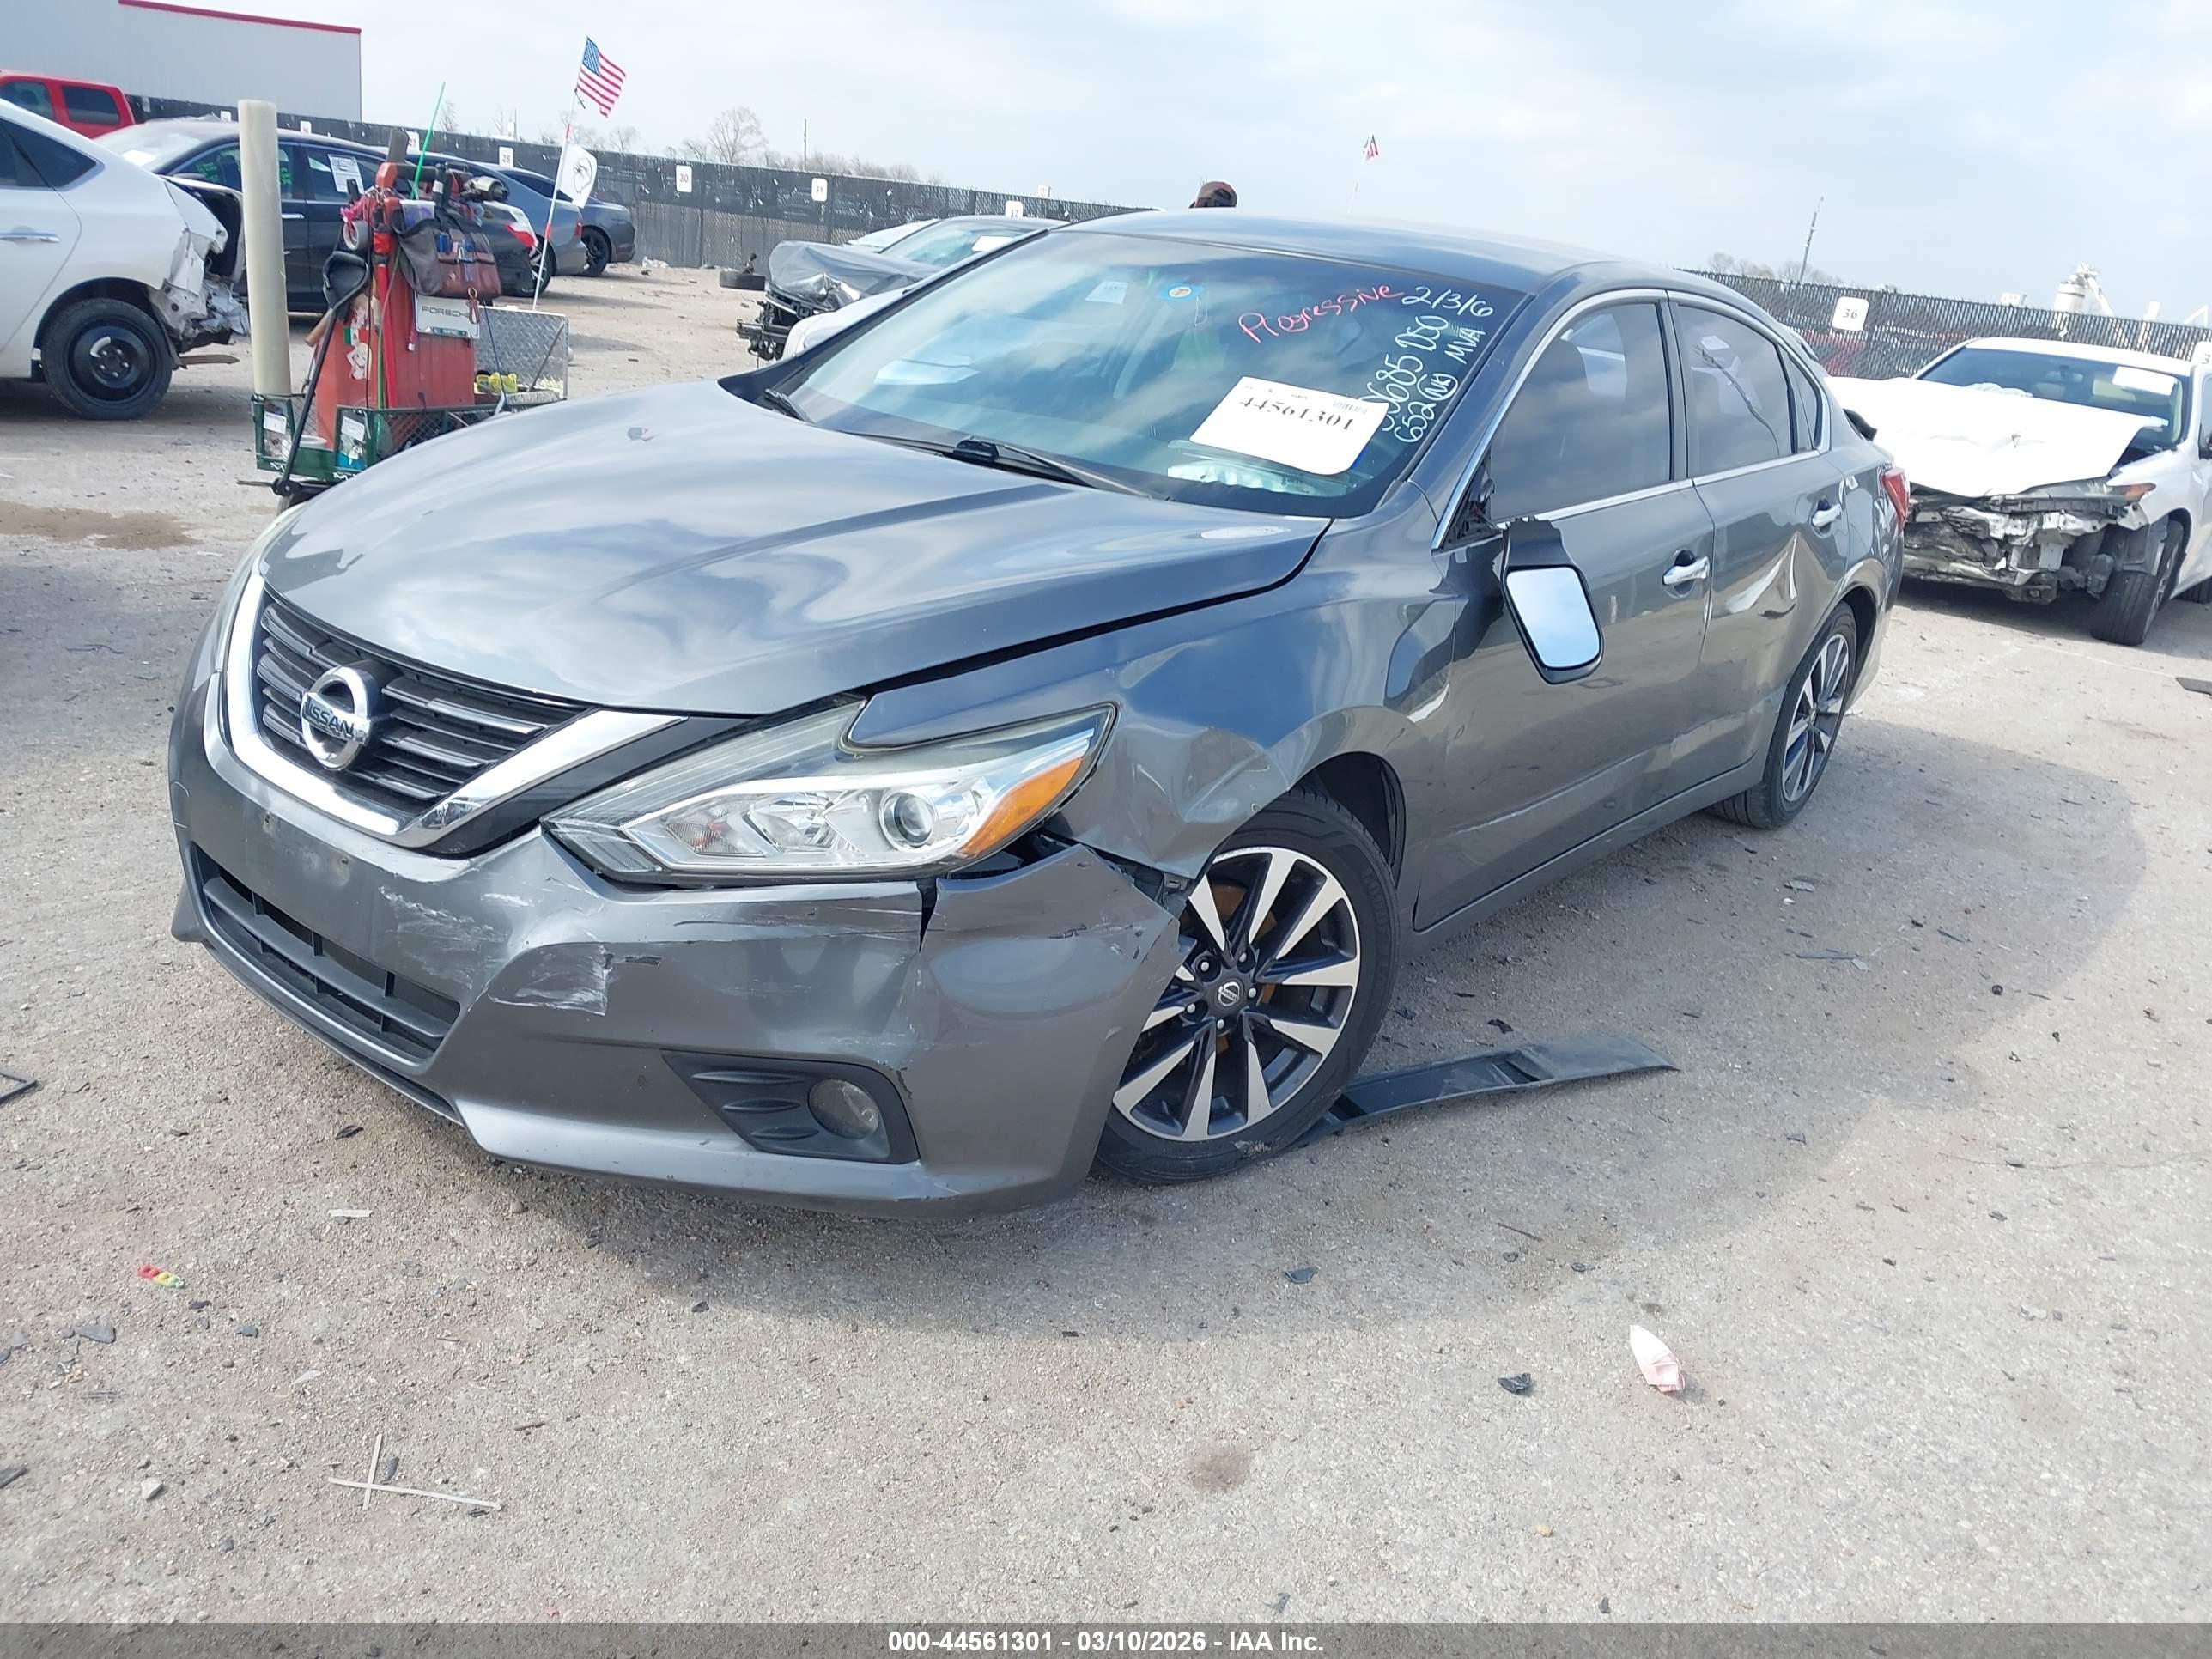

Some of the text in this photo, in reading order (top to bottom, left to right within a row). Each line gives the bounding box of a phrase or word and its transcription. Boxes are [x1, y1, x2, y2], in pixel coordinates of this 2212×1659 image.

[678, 173, 689, 183] 30
[1842, 308, 1858, 319] 36
[1239, 397, 1354, 431] 44561301
[302, 696, 355, 739] NISSAN
